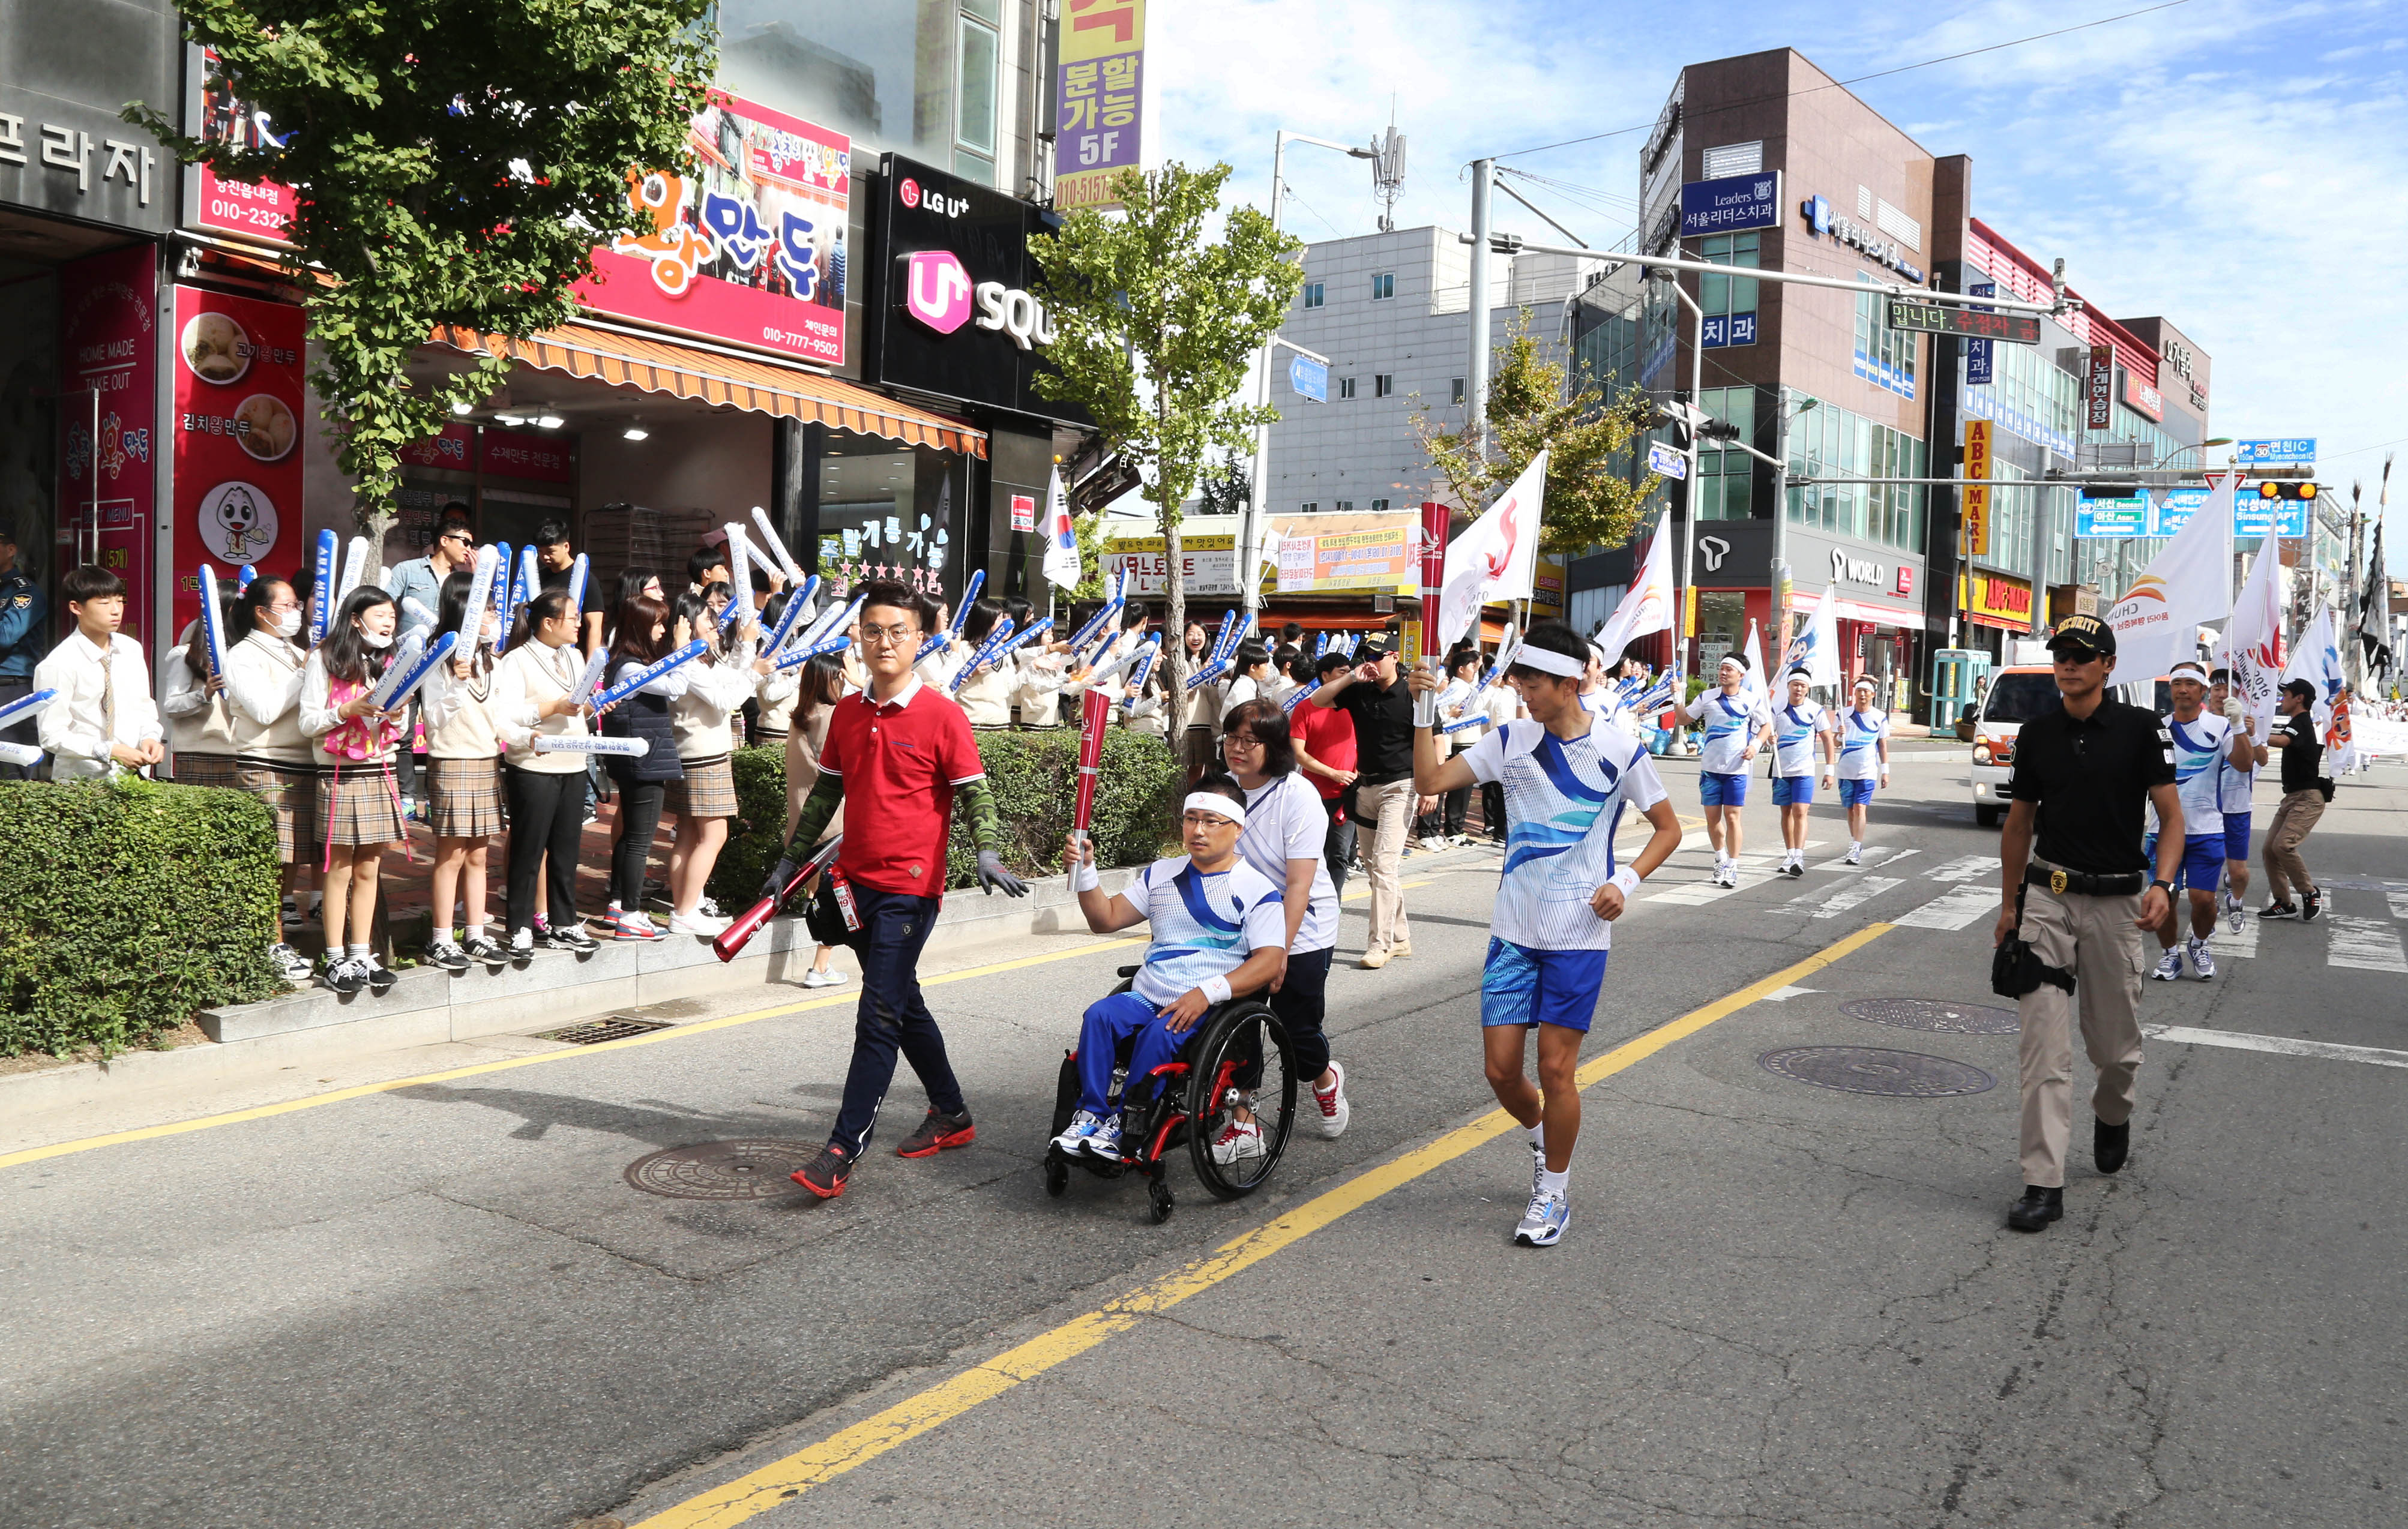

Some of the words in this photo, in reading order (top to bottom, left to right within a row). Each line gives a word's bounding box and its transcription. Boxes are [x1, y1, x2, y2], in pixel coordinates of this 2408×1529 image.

[1065, 55, 1138, 97] 분할
[1063, 94, 1136, 131] 가능
[1079, 131, 1119, 165] 5F
[922, 189, 944, 214] LG
[1715, 192, 1751, 207] Leaders
[1685, 202, 1774, 229] 서울리더스치과
[1828, 211, 1898, 271] 서울리더스치과
[805, 319, 837, 337] 체인문의
[1703, 317, 1754, 343] 치과
[79, 344, 105, 364] HOME
[108, 338, 135, 358] MADE
[235, 341, 296, 365] 고기왕만두
[763, 326, 838, 356] 010-7777-9502
[112, 372, 131, 390] OUT
[2092, 361, 2109, 424] 노래연습장
[182, 413, 250, 437] 김치왕만두
[490, 446, 529, 464] 수제만두
[106, 507, 130, 522] MENU
[2097, 498, 2115, 508] 서산
[2096, 511, 2115, 521] 아산
[2236, 512, 2274, 523] Sinsung
[2277, 512, 2299, 521] APT
[819, 527, 862, 567] 주말
[861, 515, 901, 548] 개통
[906, 530, 944, 569] 가능
[1847, 557, 1884, 586] WORLD
[2056, 616, 2101, 635] SECURITY
